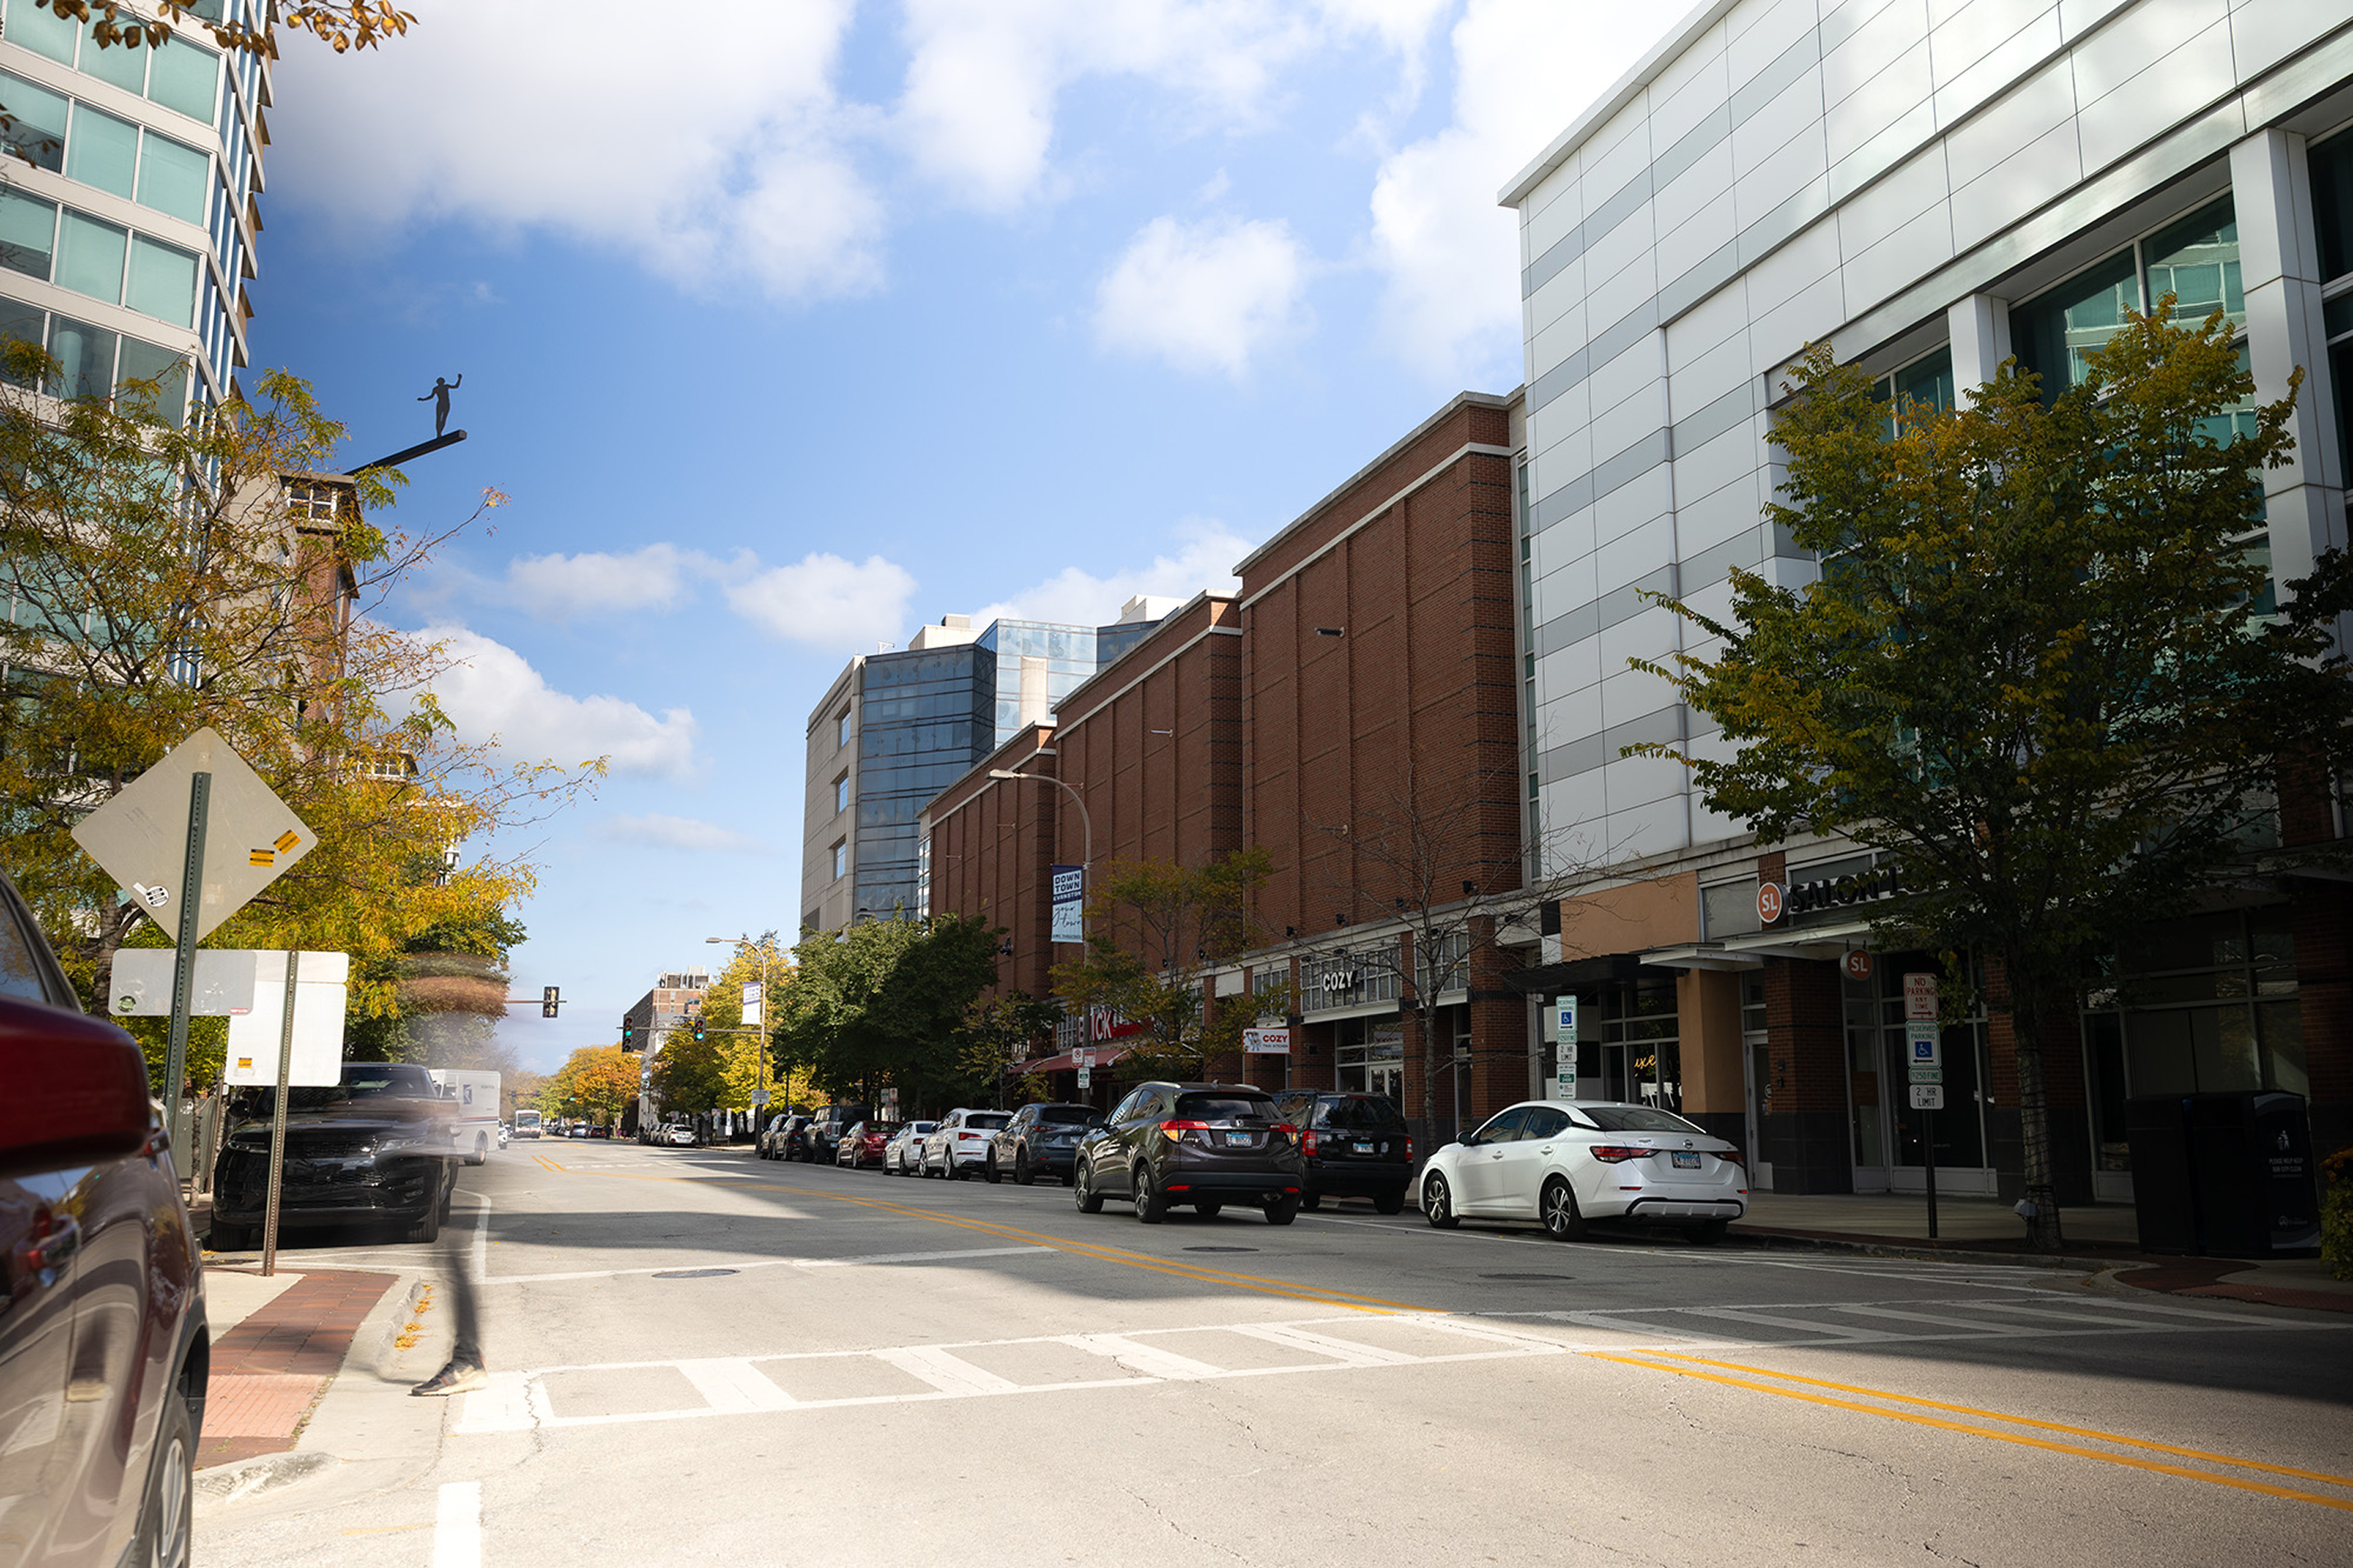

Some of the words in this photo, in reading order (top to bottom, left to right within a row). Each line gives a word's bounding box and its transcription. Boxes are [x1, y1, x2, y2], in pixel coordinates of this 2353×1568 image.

[1055, 873, 1080, 884] DOWN
[1055, 881, 1079, 892] TOWN
[1789, 872, 1881, 912] SALON
[1054, 891, 1082, 902] EVANSTON
[1761, 893, 1778, 912] SL
[1850, 956, 1868, 973] SL
[1323, 971, 1353, 992] COZY
[1914, 978, 1926, 986] NO
[1907, 987, 1935, 995] PARKING
[1079, 1011, 1112, 1043] BICK
[1263, 1034, 1288, 1042] COZY
[1927, 1071, 1939, 1080] FINE
[1916, 1088, 1921, 1096] 2
[1927, 1088, 1937, 1096] HR
[1918, 1097, 1935, 1107] LIMIT
